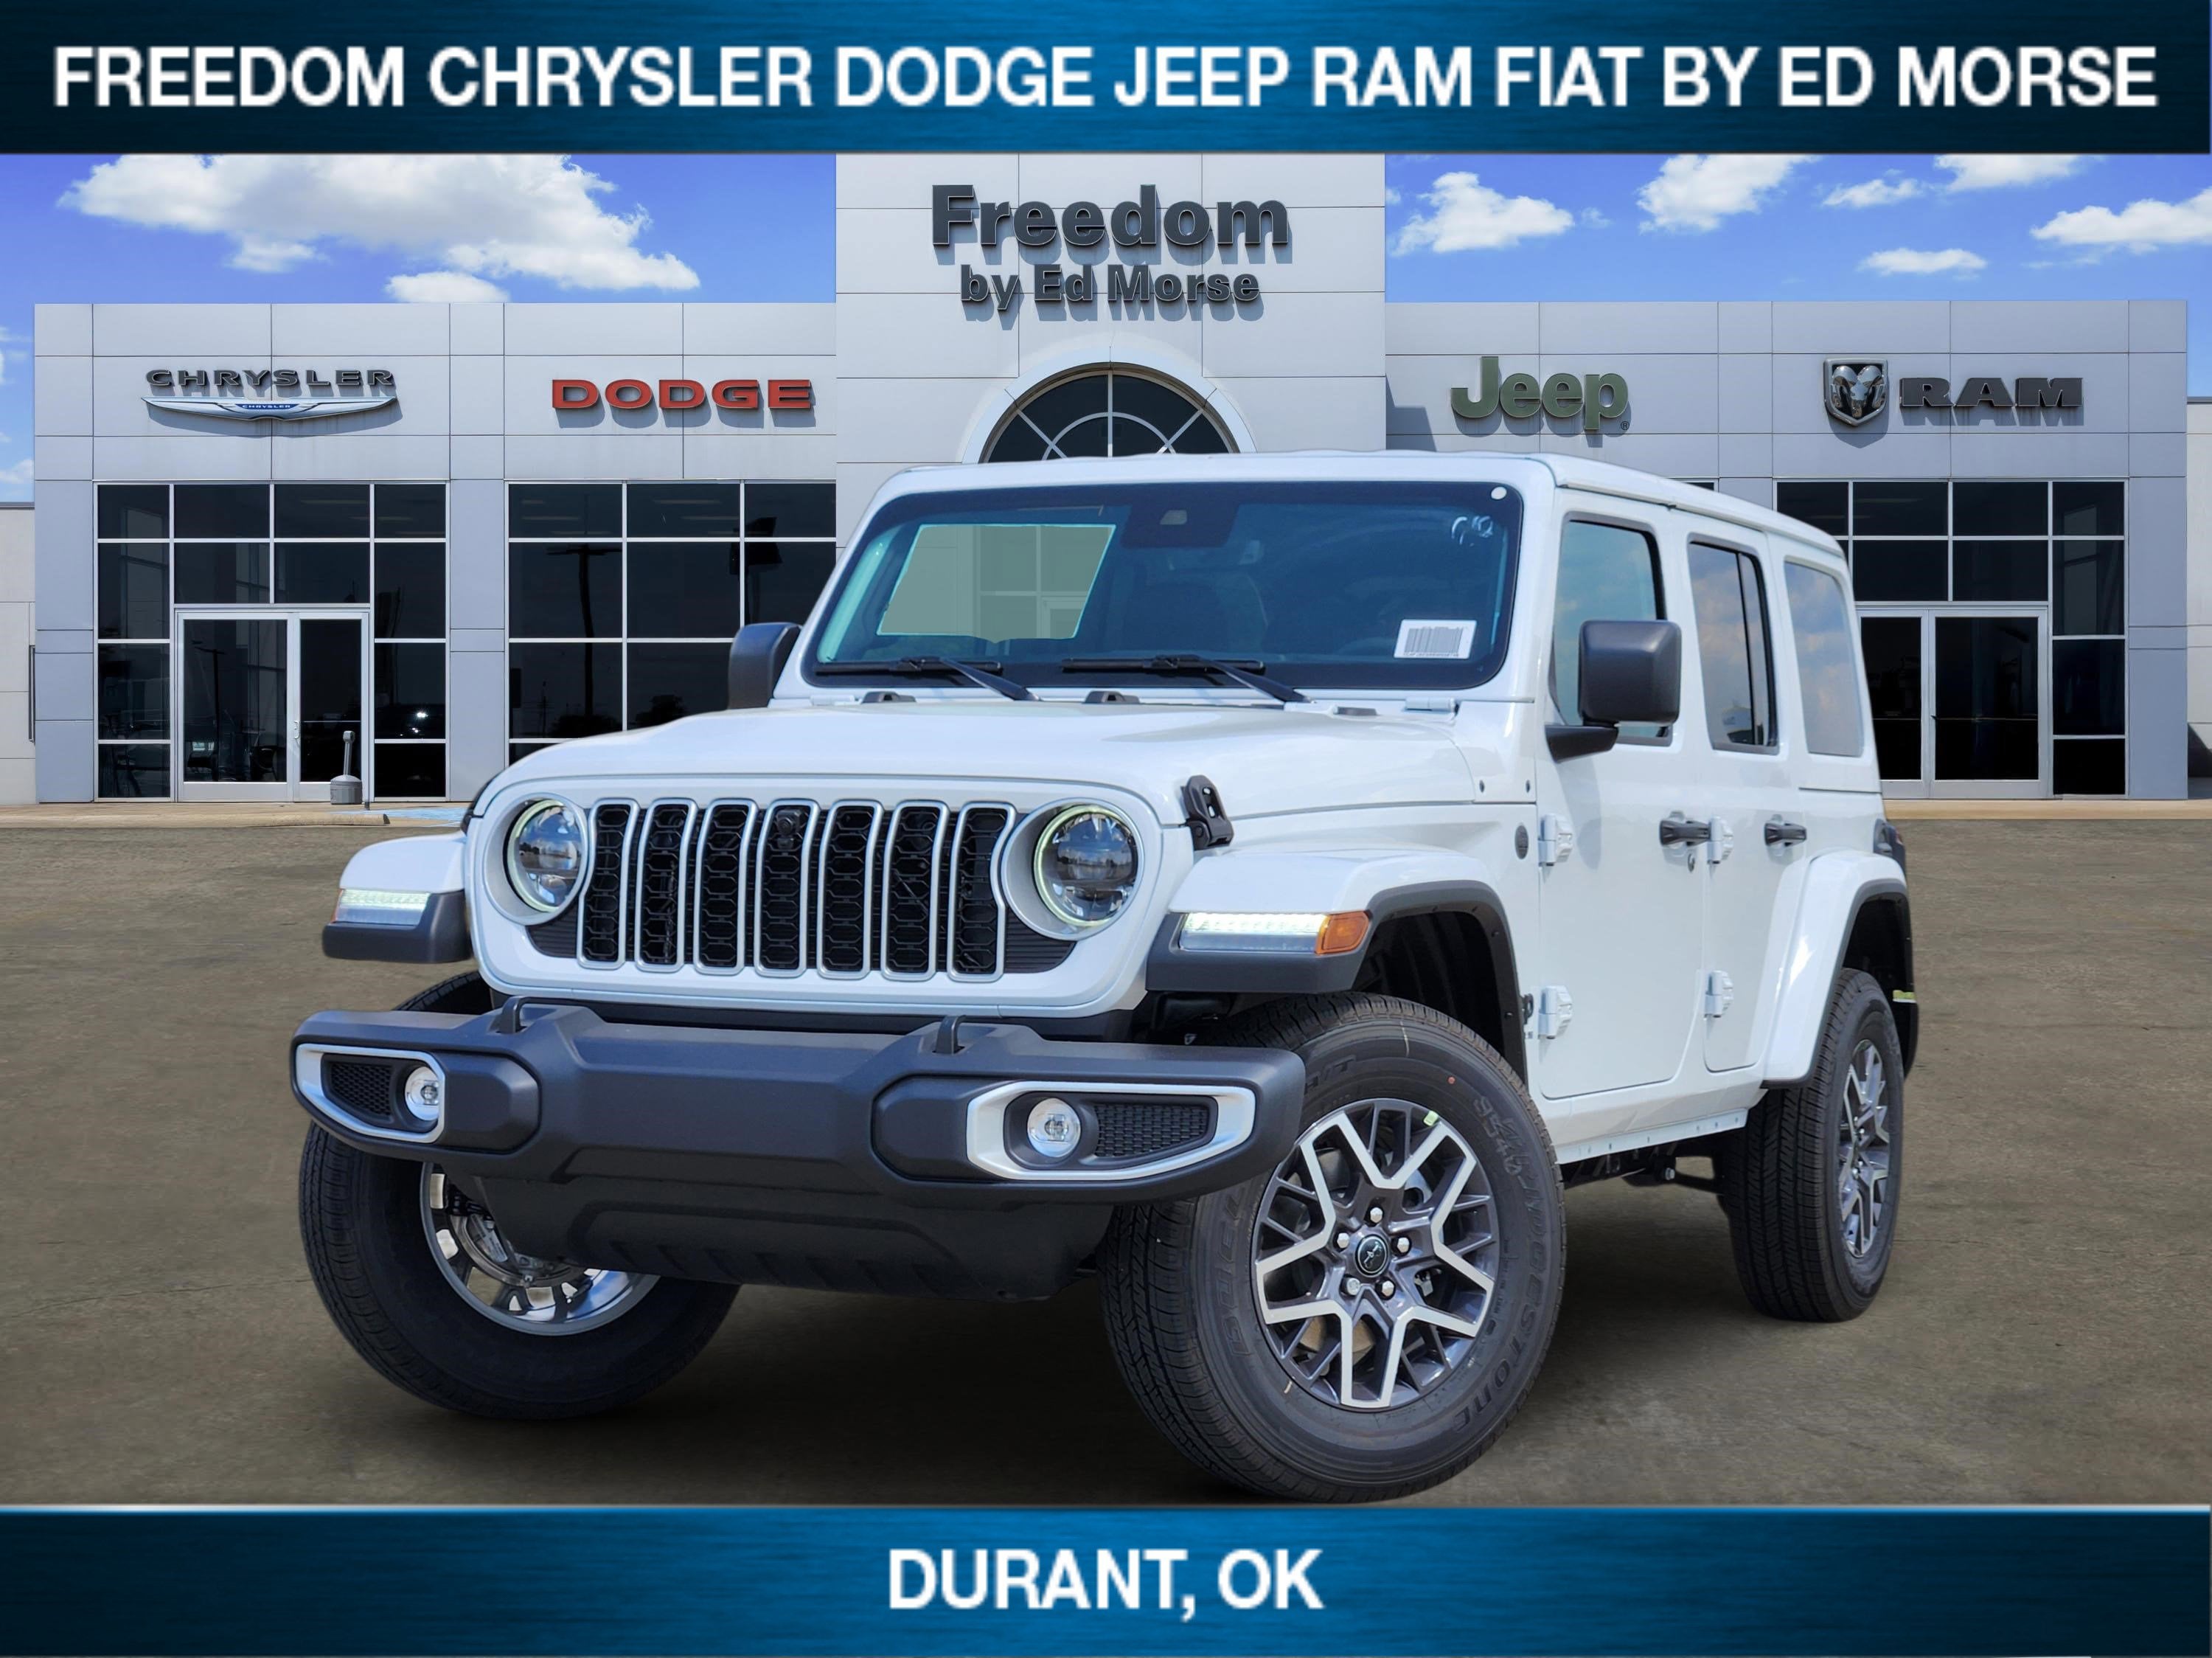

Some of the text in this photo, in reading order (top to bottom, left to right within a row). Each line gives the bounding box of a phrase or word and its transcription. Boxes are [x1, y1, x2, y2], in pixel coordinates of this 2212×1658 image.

[932, 184, 1289, 246] Freedom
[961, 264, 1259, 310] by Ed Morse
[145, 369, 394, 387] CHRYSLER
[552, 378, 811, 409] DODGE
[1450, 356, 1628, 430] Jeep
[1899, 377, 2083, 406] RAM
